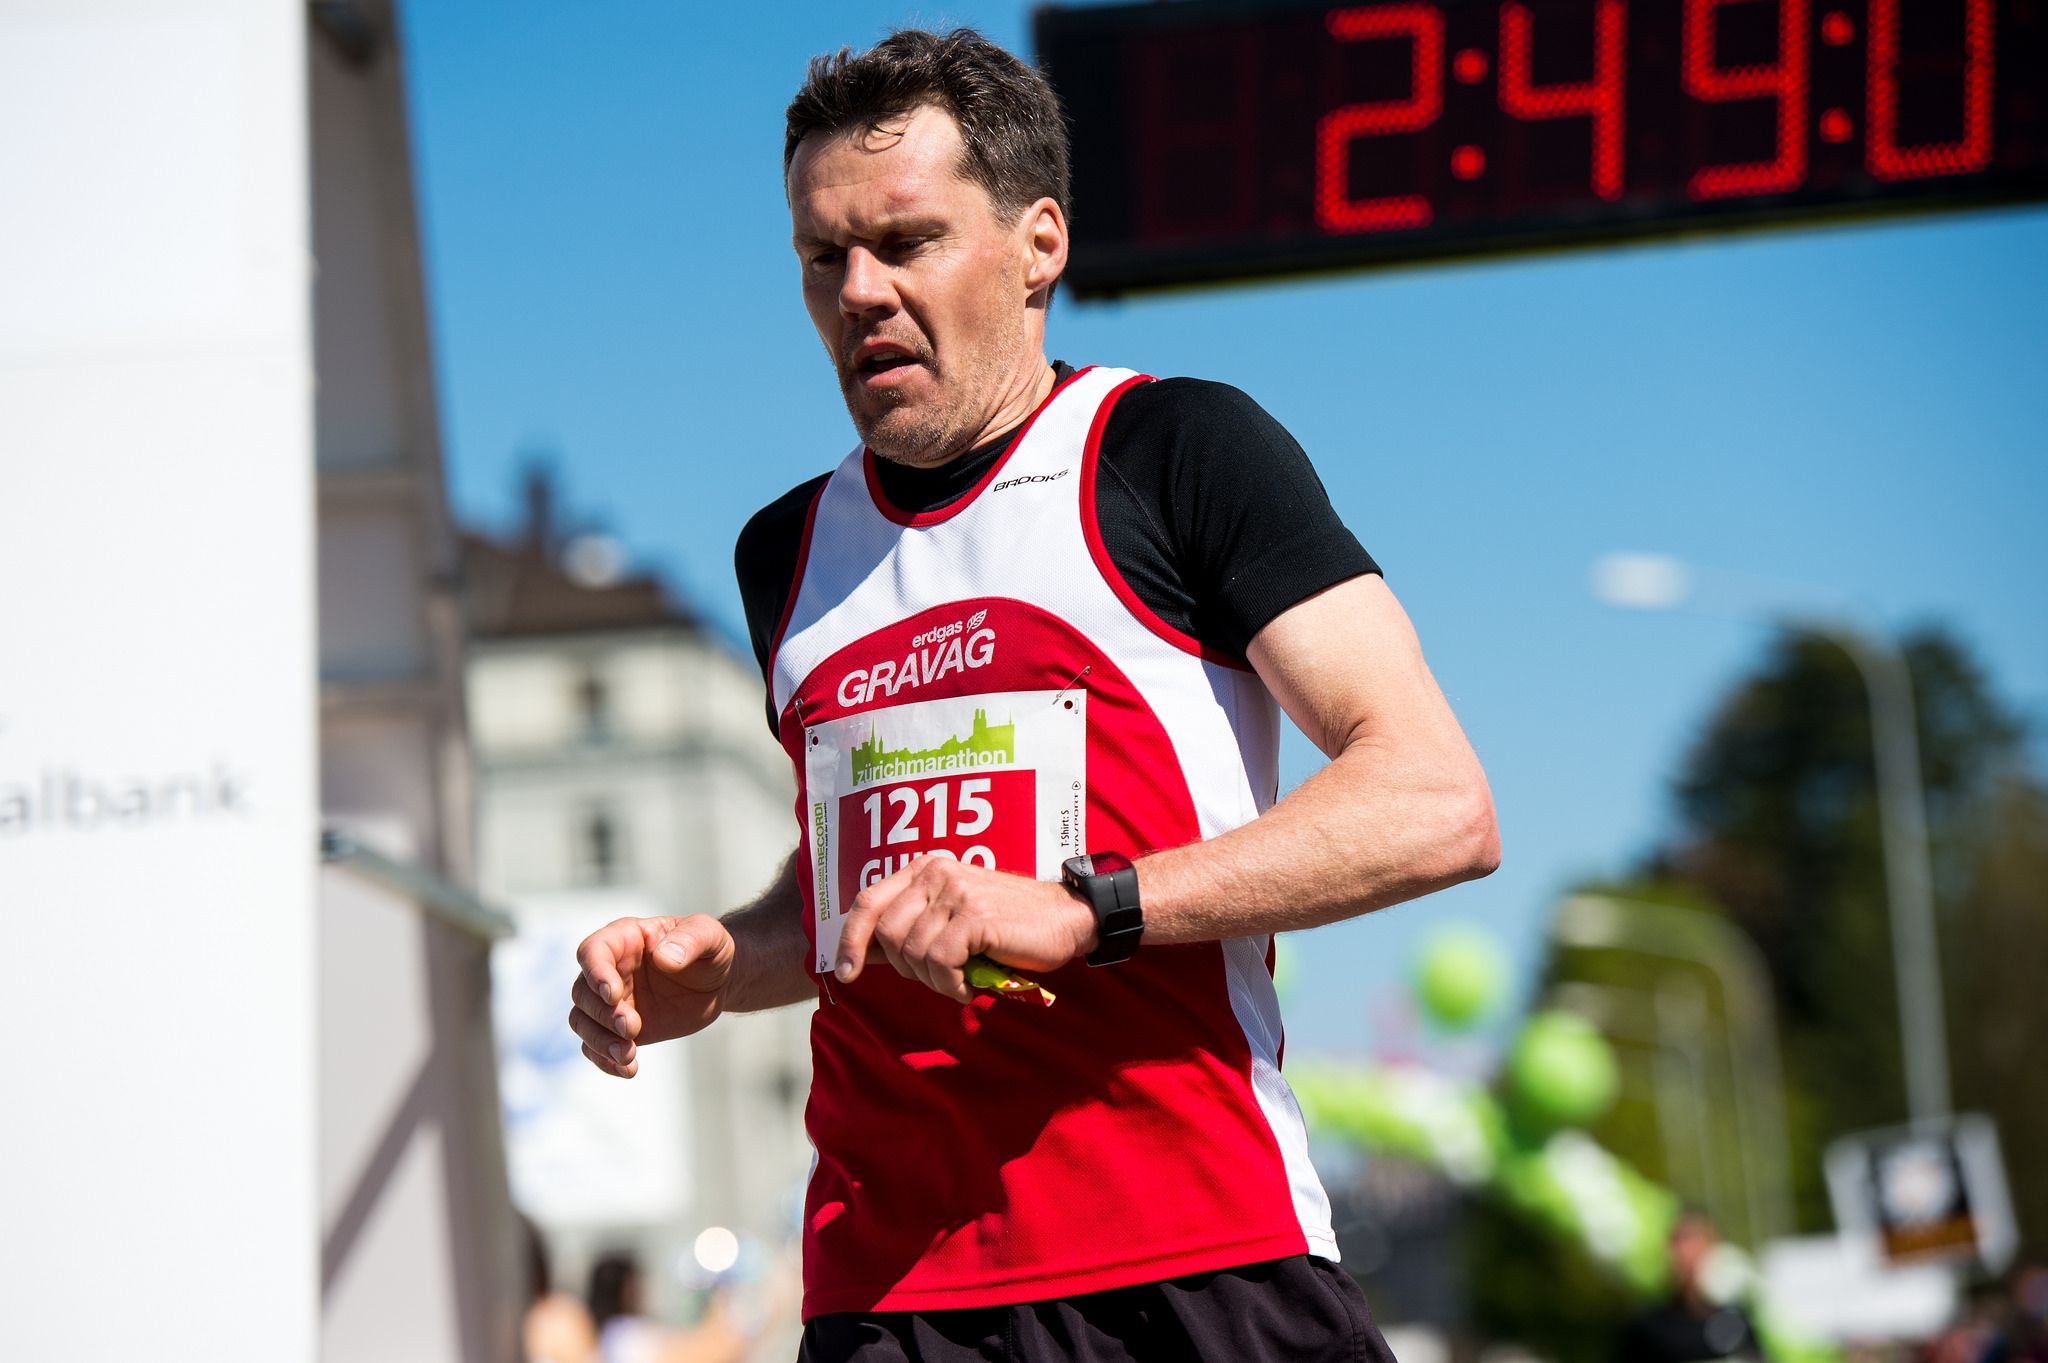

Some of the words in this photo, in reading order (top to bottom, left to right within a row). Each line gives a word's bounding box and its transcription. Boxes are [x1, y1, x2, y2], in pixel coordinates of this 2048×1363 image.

[993, 469, 1069, 492] BROOKS
[912, 620, 963, 648] erdgas
[837, 628, 996, 708] GRAVAG
[856, 748, 1007, 786] zürichmarathon
[863, 777, 994, 849] 1215
[814, 802, 825, 866] RECORD!
[1061, 816, 1069, 847] T-Shirt:
[819, 891, 828, 921] RUN
